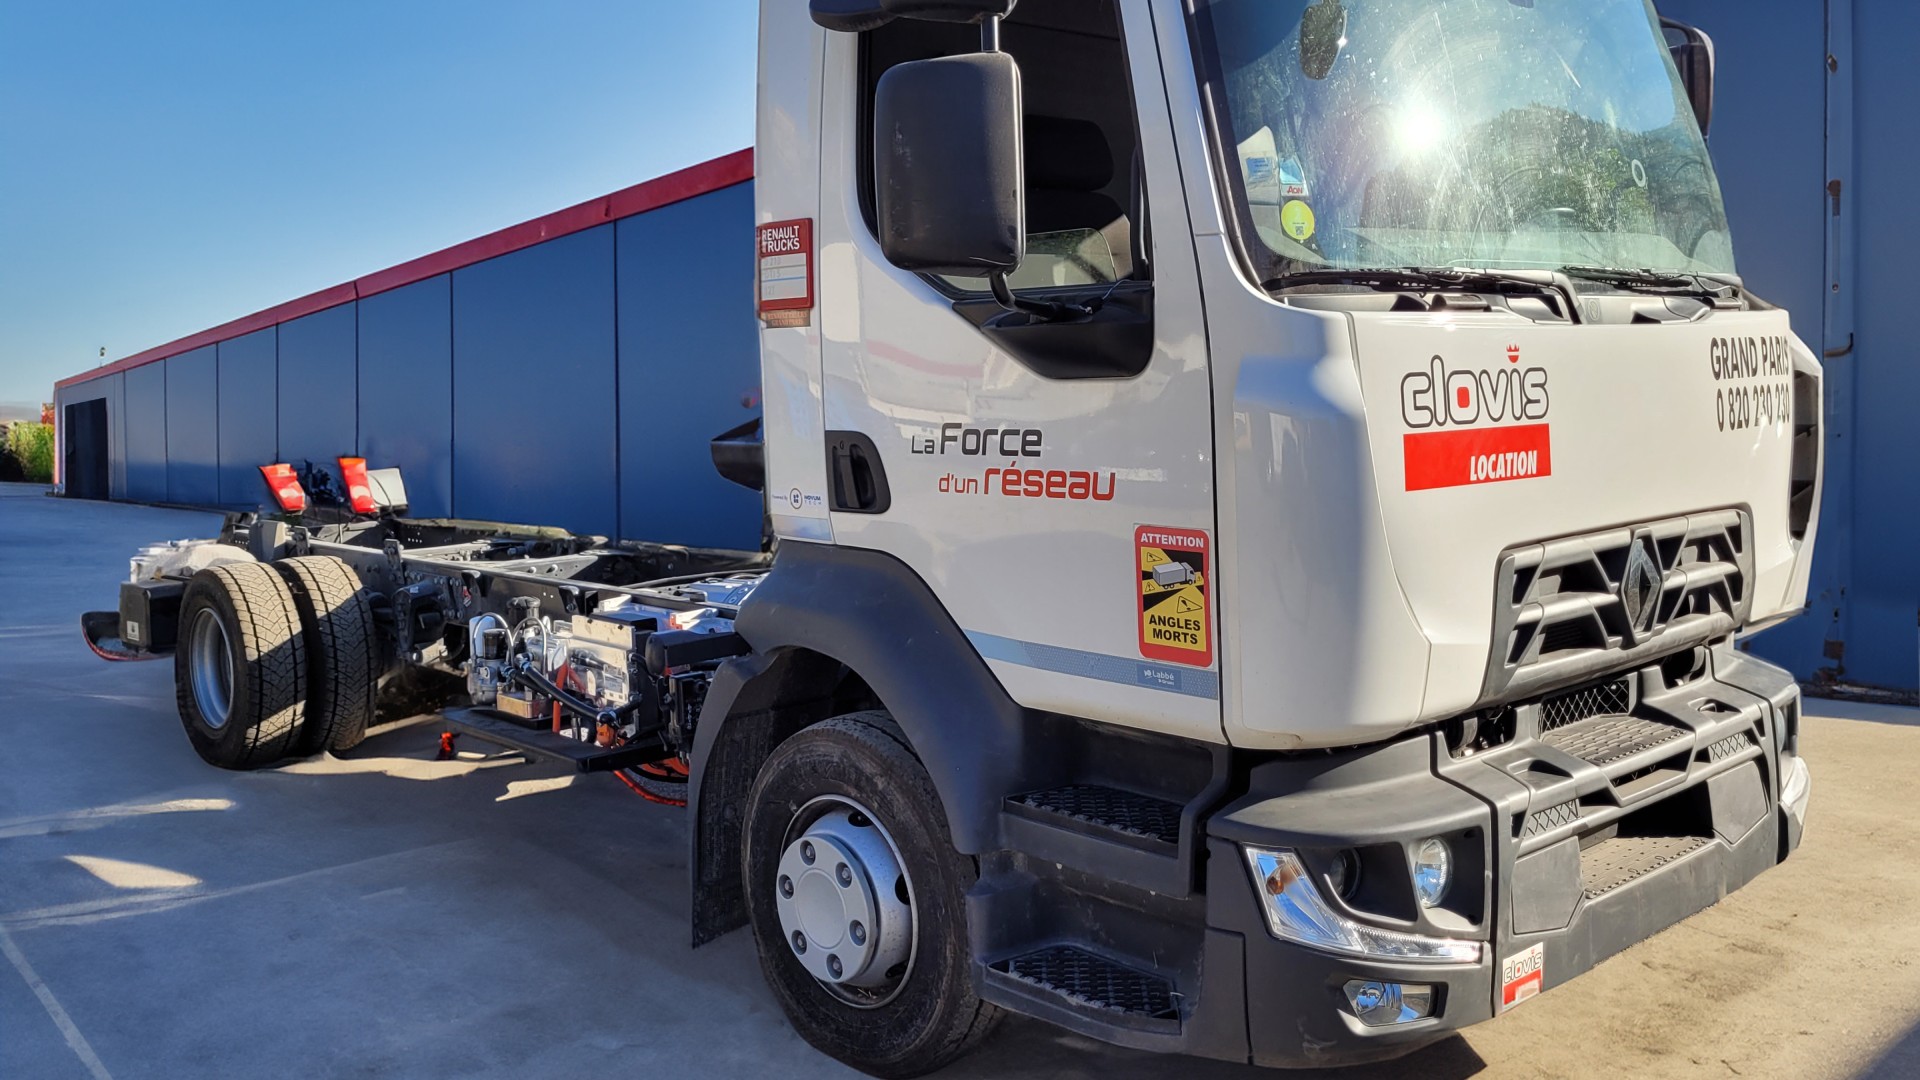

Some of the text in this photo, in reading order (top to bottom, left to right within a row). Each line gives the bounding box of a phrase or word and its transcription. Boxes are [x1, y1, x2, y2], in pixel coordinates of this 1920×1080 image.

[762, 225, 800, 242] RENAULT
[762, 238, 800, 253] TRUCKS
[1710, 336, 1789, 380] GRAND PARIS
[1400, 351, 1549, 428] clovis
[1716, 383, 1790, 432] 0 820 230 230
[911, 423, 1043, 457] La Force
[938, 461, 1116, 501] d'un réseau
[1470, 450, 1538, 481] LOCATION
[1140, 532, 1204, 548] ATTENTION
[1149, 614, 1201, 631] ANGLES
[1152, 628, 1198, 645] MORTS
[1503, 950, 1543, 984] clovis
